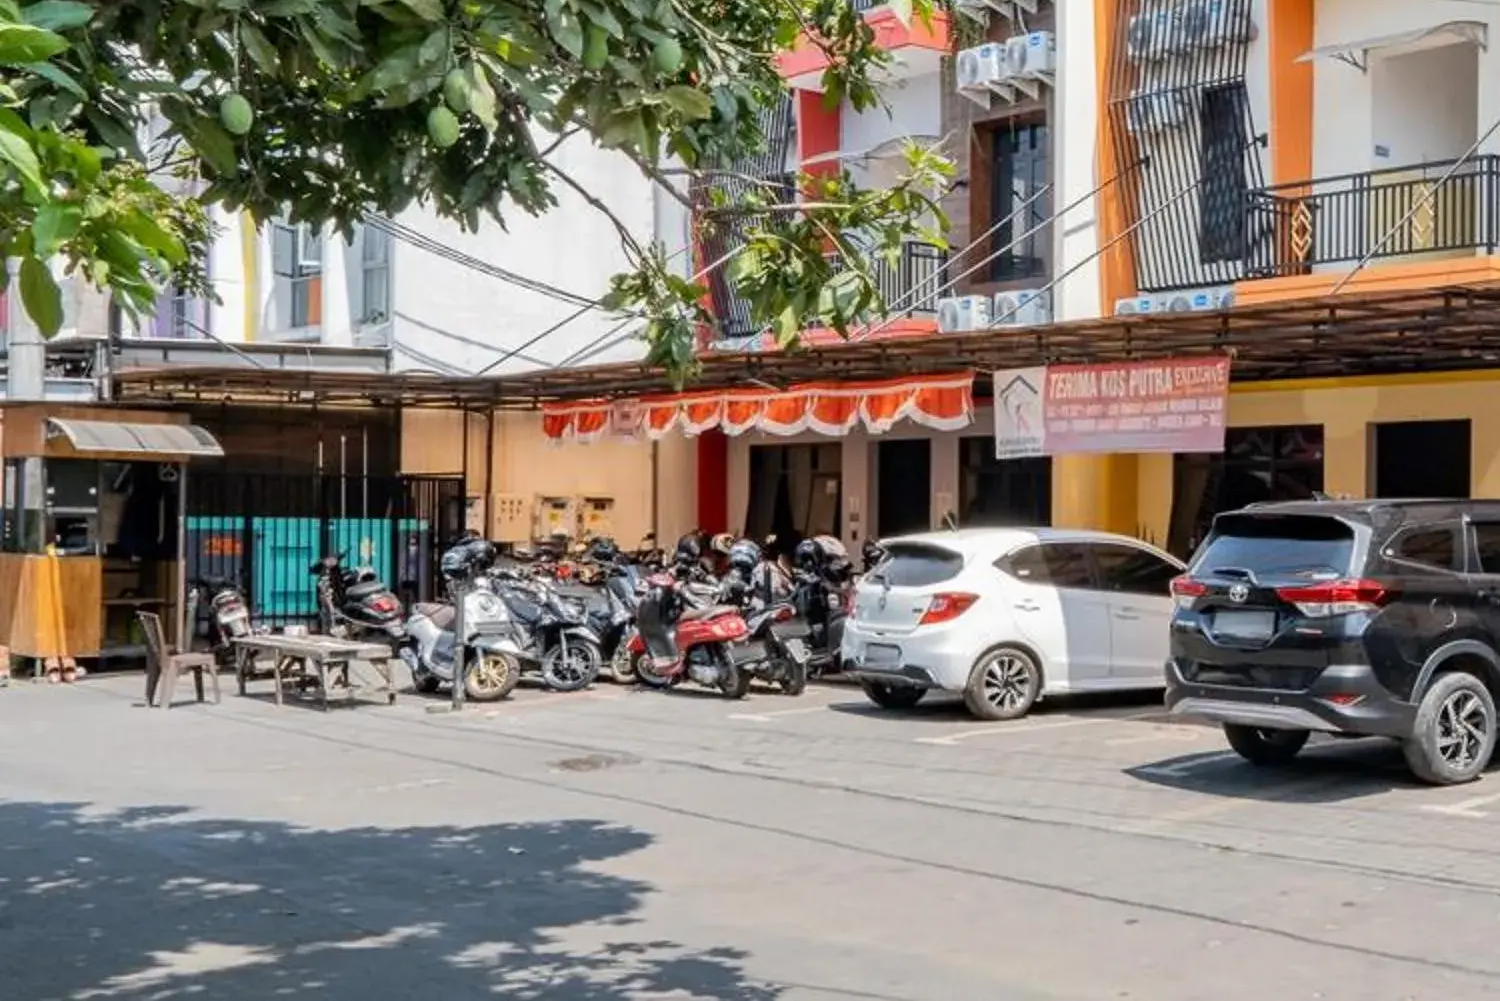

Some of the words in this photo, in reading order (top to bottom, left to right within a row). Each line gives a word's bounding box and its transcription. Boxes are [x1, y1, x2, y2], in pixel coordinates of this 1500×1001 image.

[1049, 371, 1098, 399] TERIMA
[1101, 369, 1126, 397] KOS
[1129, 366, 1173, 396] PUTRA
